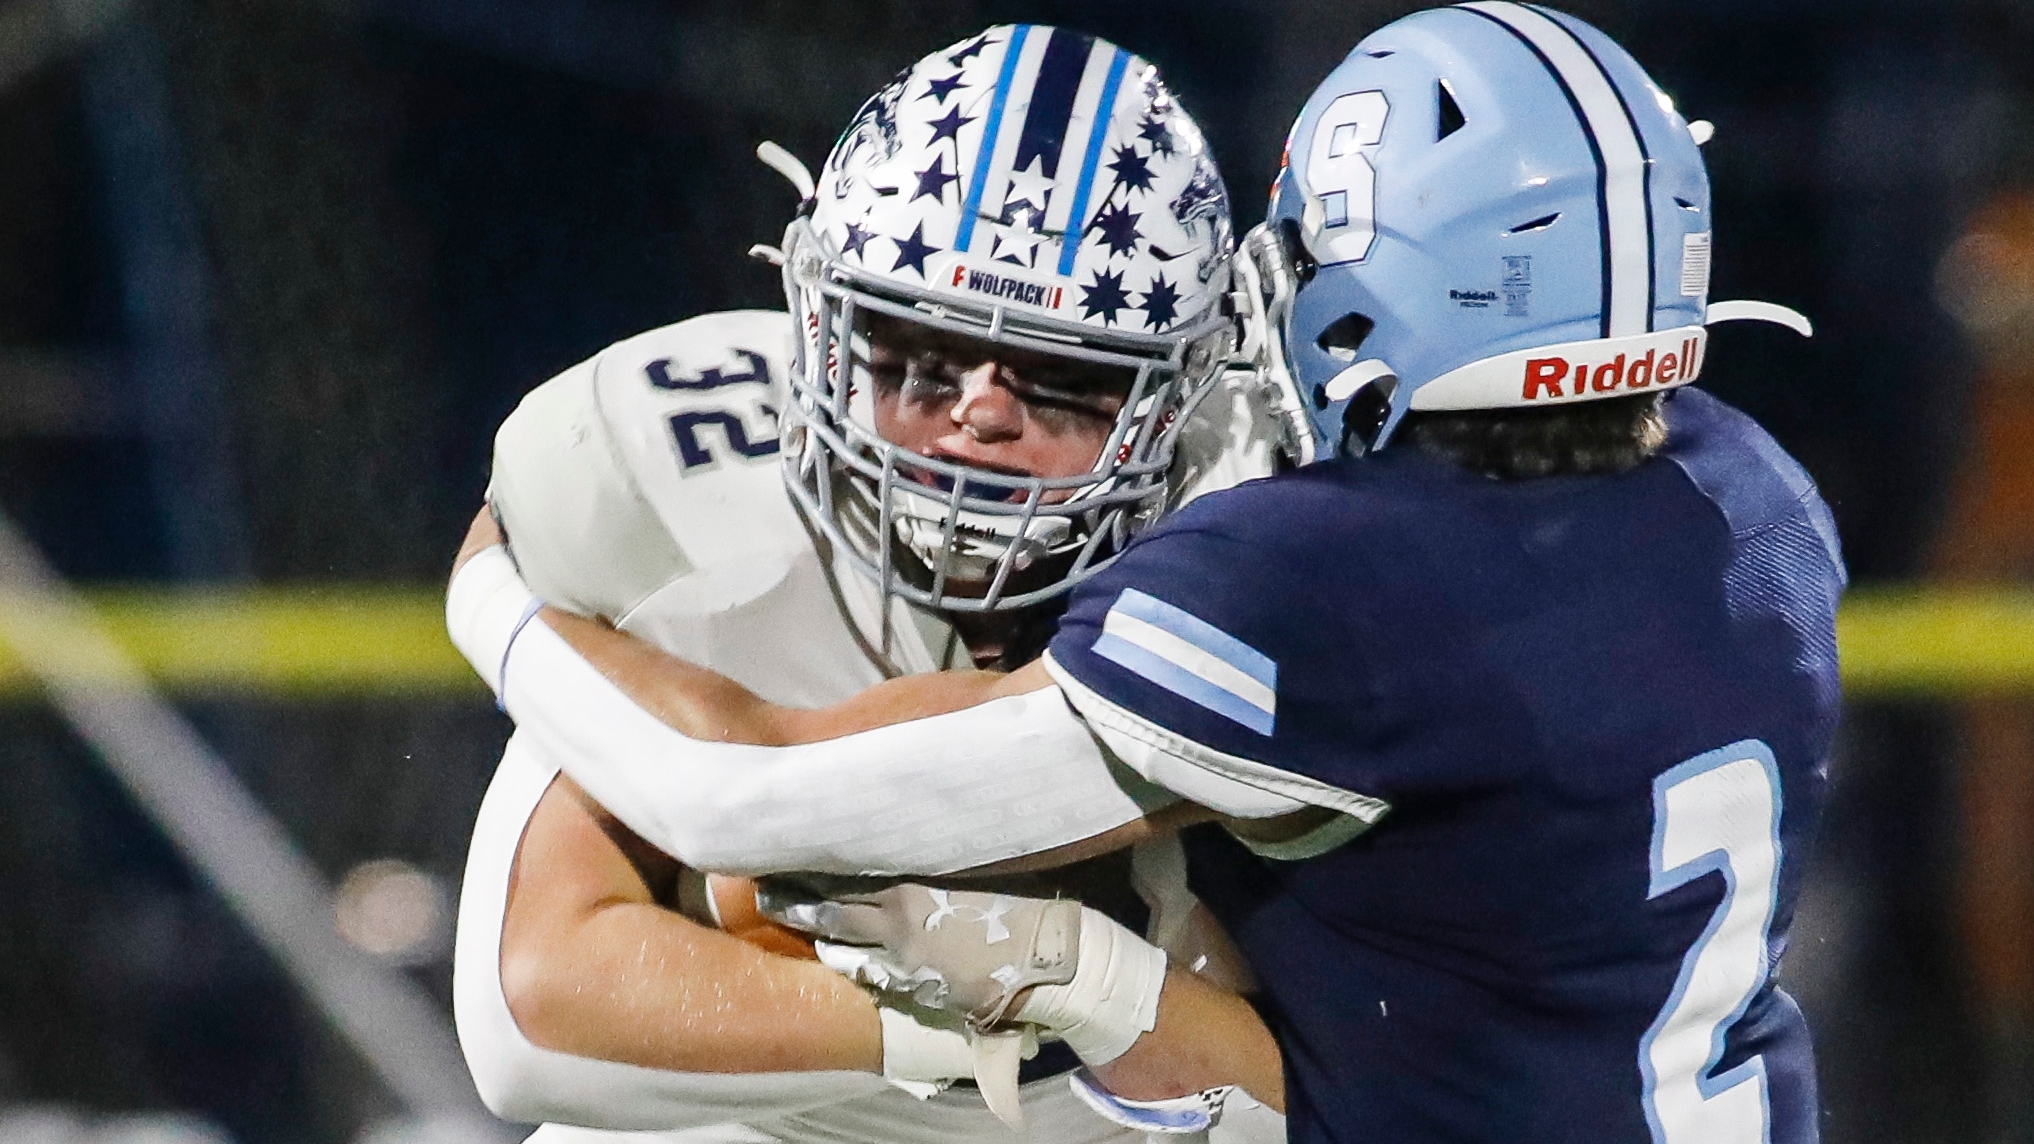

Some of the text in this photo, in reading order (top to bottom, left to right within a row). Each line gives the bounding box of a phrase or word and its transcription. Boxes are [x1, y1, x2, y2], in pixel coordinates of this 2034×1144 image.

[1301, 89, 1392, 268] S
[968, 269, 1047, 306] WOLFPACK
[645, 347, 781, 469] 32
[1522, 337, 1699, 400] Riddell
[1638, 738, 1783, 1144] 2
